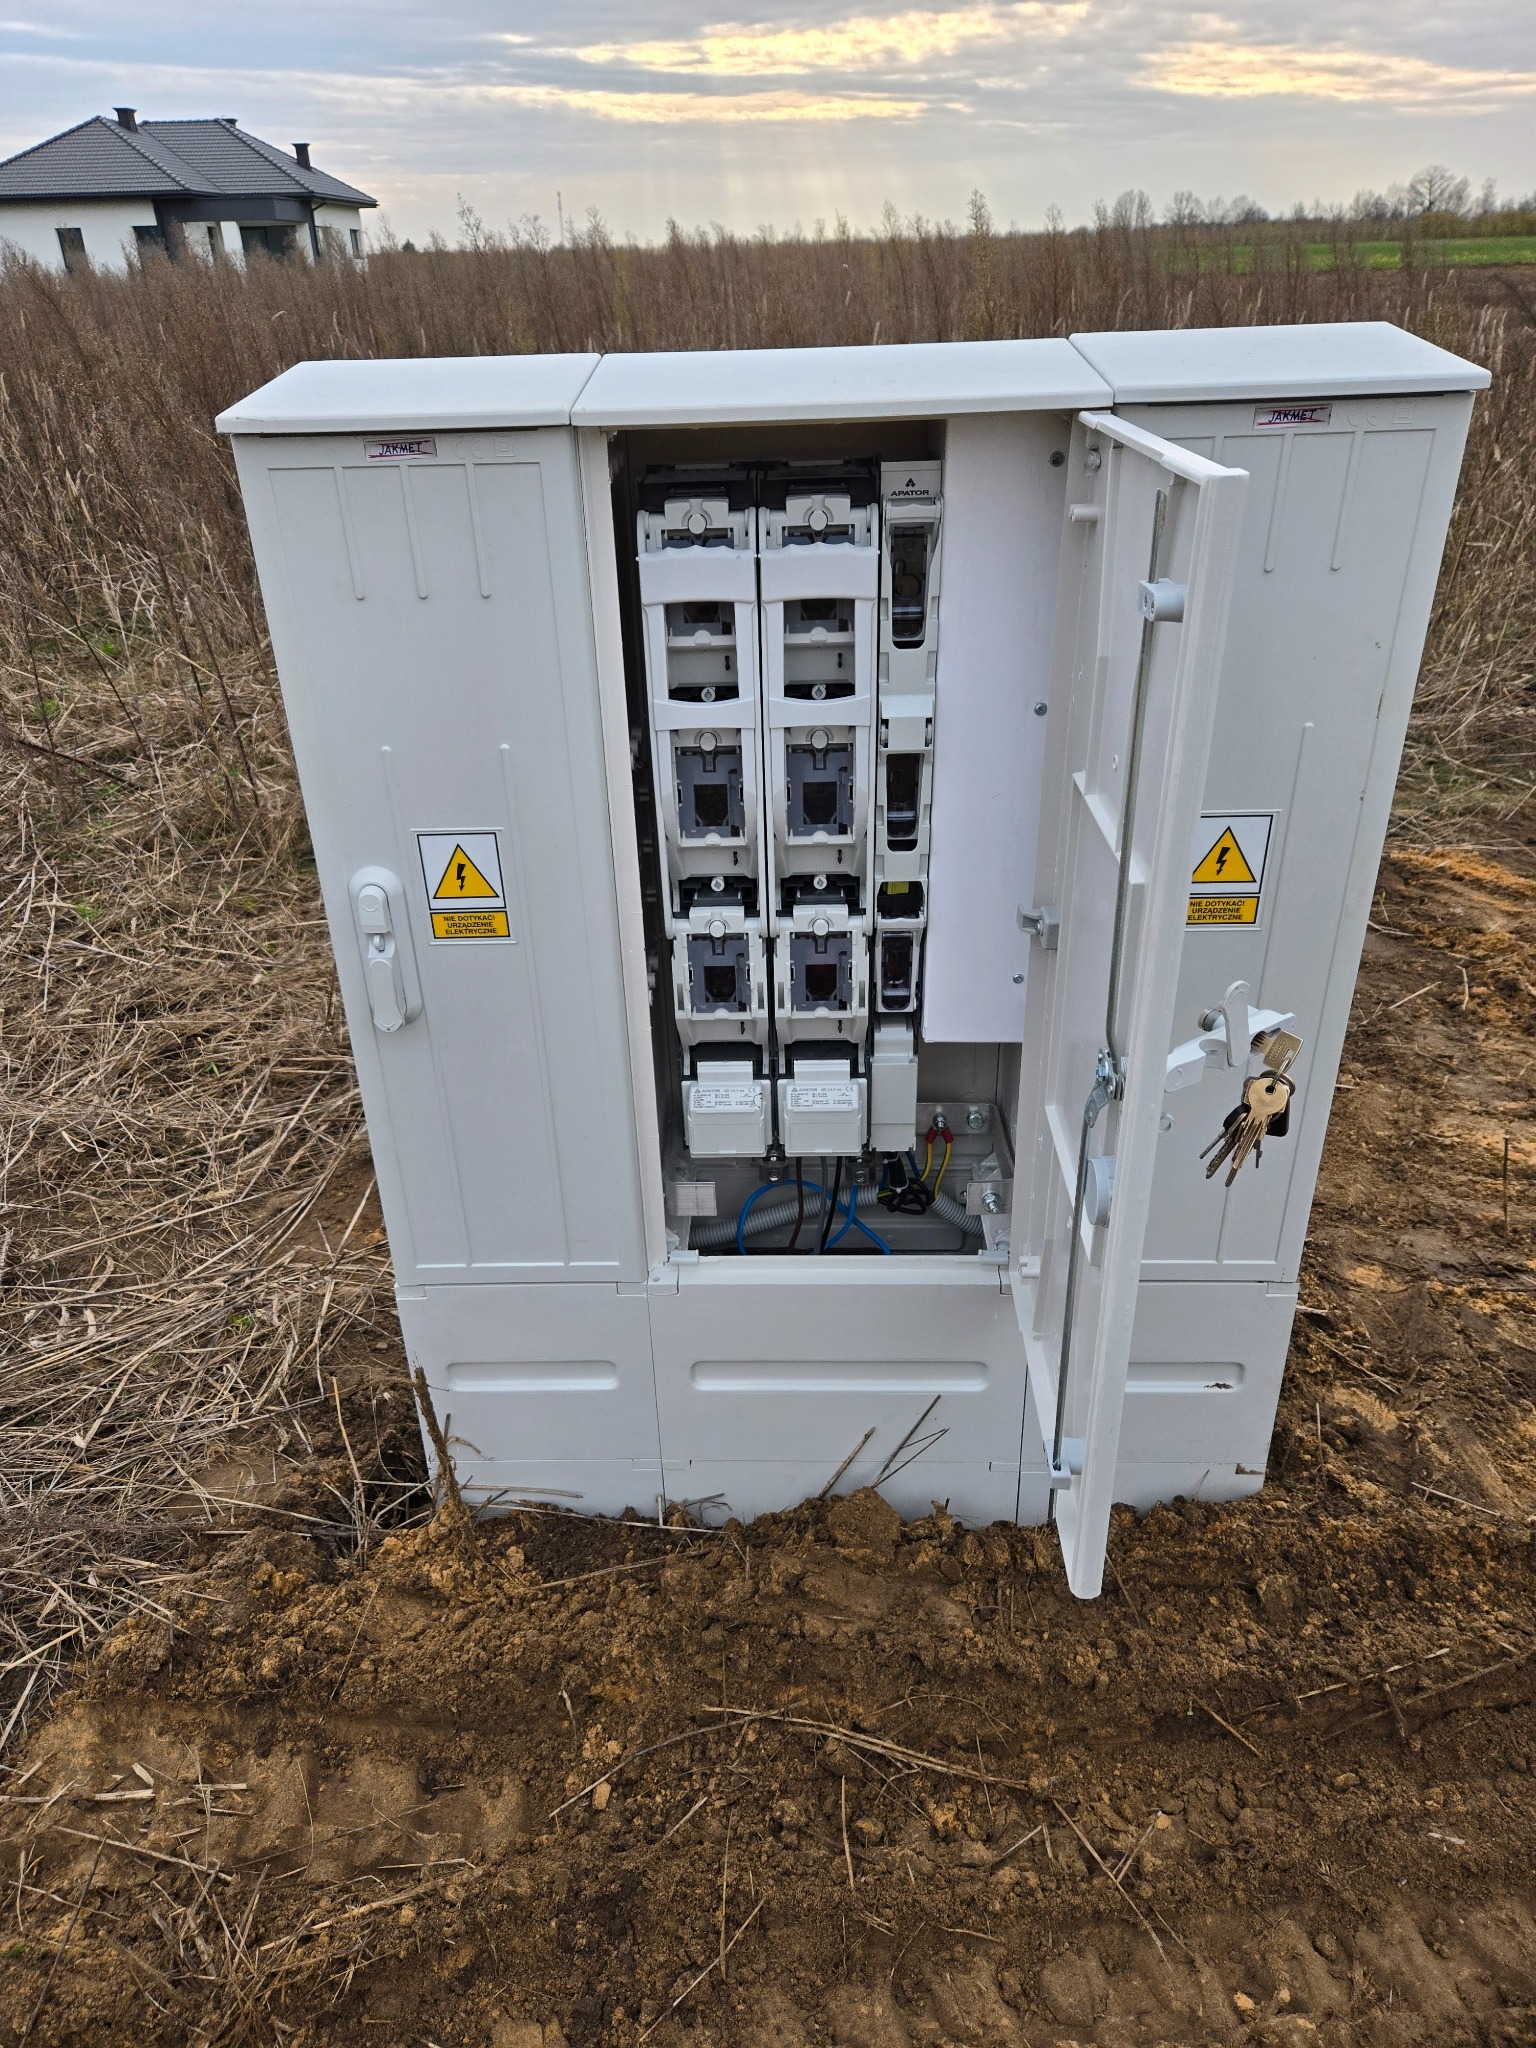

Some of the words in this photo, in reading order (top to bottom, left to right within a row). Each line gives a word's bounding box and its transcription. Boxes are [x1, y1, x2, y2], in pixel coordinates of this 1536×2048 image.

[1268, 409, 1317, 422] JAKMET
[378, 442, 423, 455] JAKMET
[890, 489, 930, 497] APATOR
[1204, 899, 1245, 907] DOTYKAĆ!
[1191, 907, 1241, 916] URZĄDZENIE
[457, 914, 495, 922] DOTYKAĆ!
[1187, 913, 1243, 921] ELEKTRYCZNE
[447, 921, 494, 930] URZĄDZENIE
